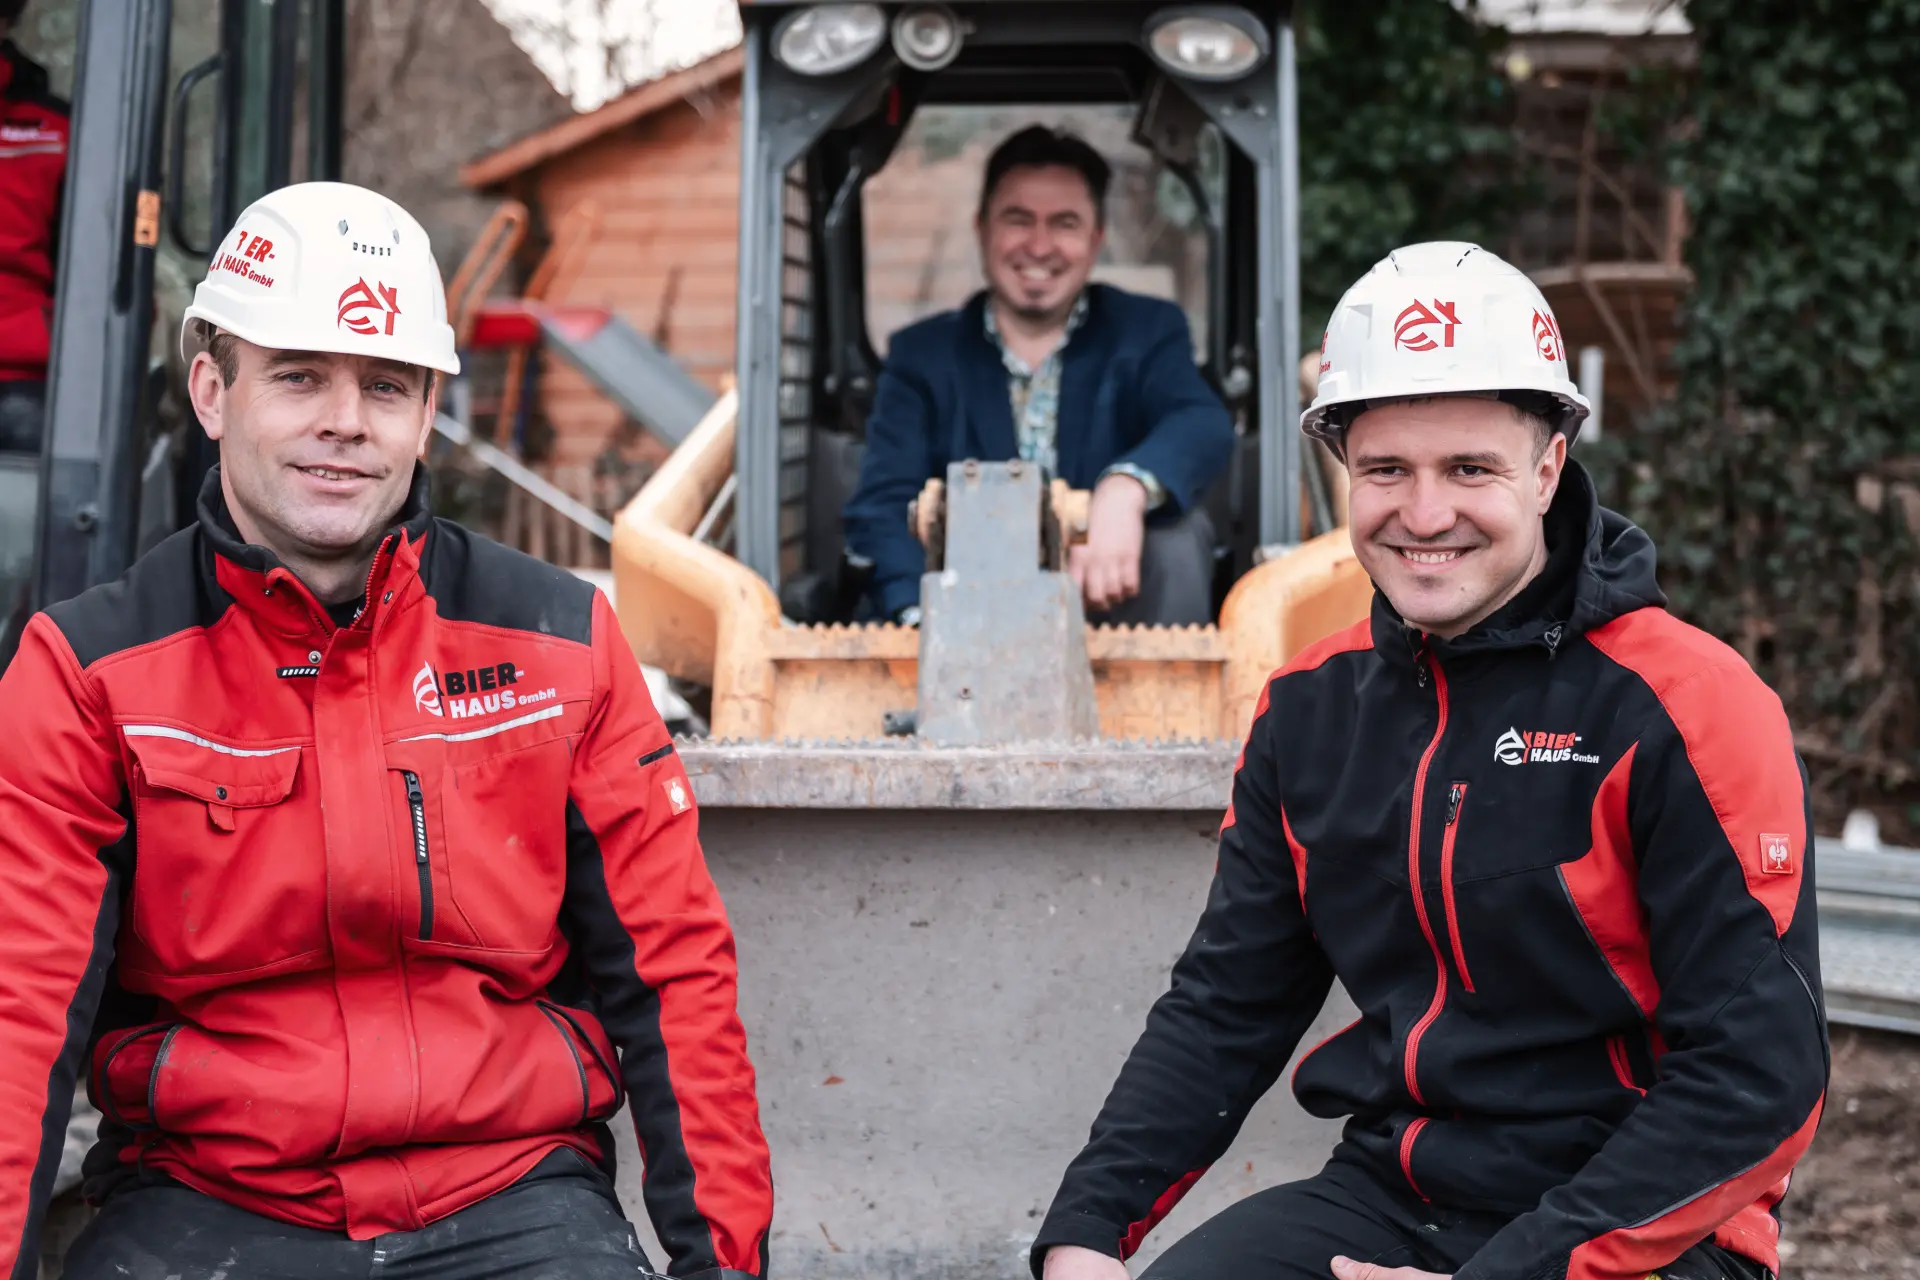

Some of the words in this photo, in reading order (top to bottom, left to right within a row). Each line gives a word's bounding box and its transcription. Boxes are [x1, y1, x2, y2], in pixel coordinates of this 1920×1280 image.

[223, 254, 251, 277] HAUS
[248, 270, 274, 288] GmbH
[444, 662, 525, 697] BIER-
[449, 690, 516, 719] HAUS
[518, 687, 557, 706] GmbH
[1530, 747, 1572, 762] HAUS
[1572, 753, 1600, 764] GmbH
[1533, 731, 1583, 749] BIER-
